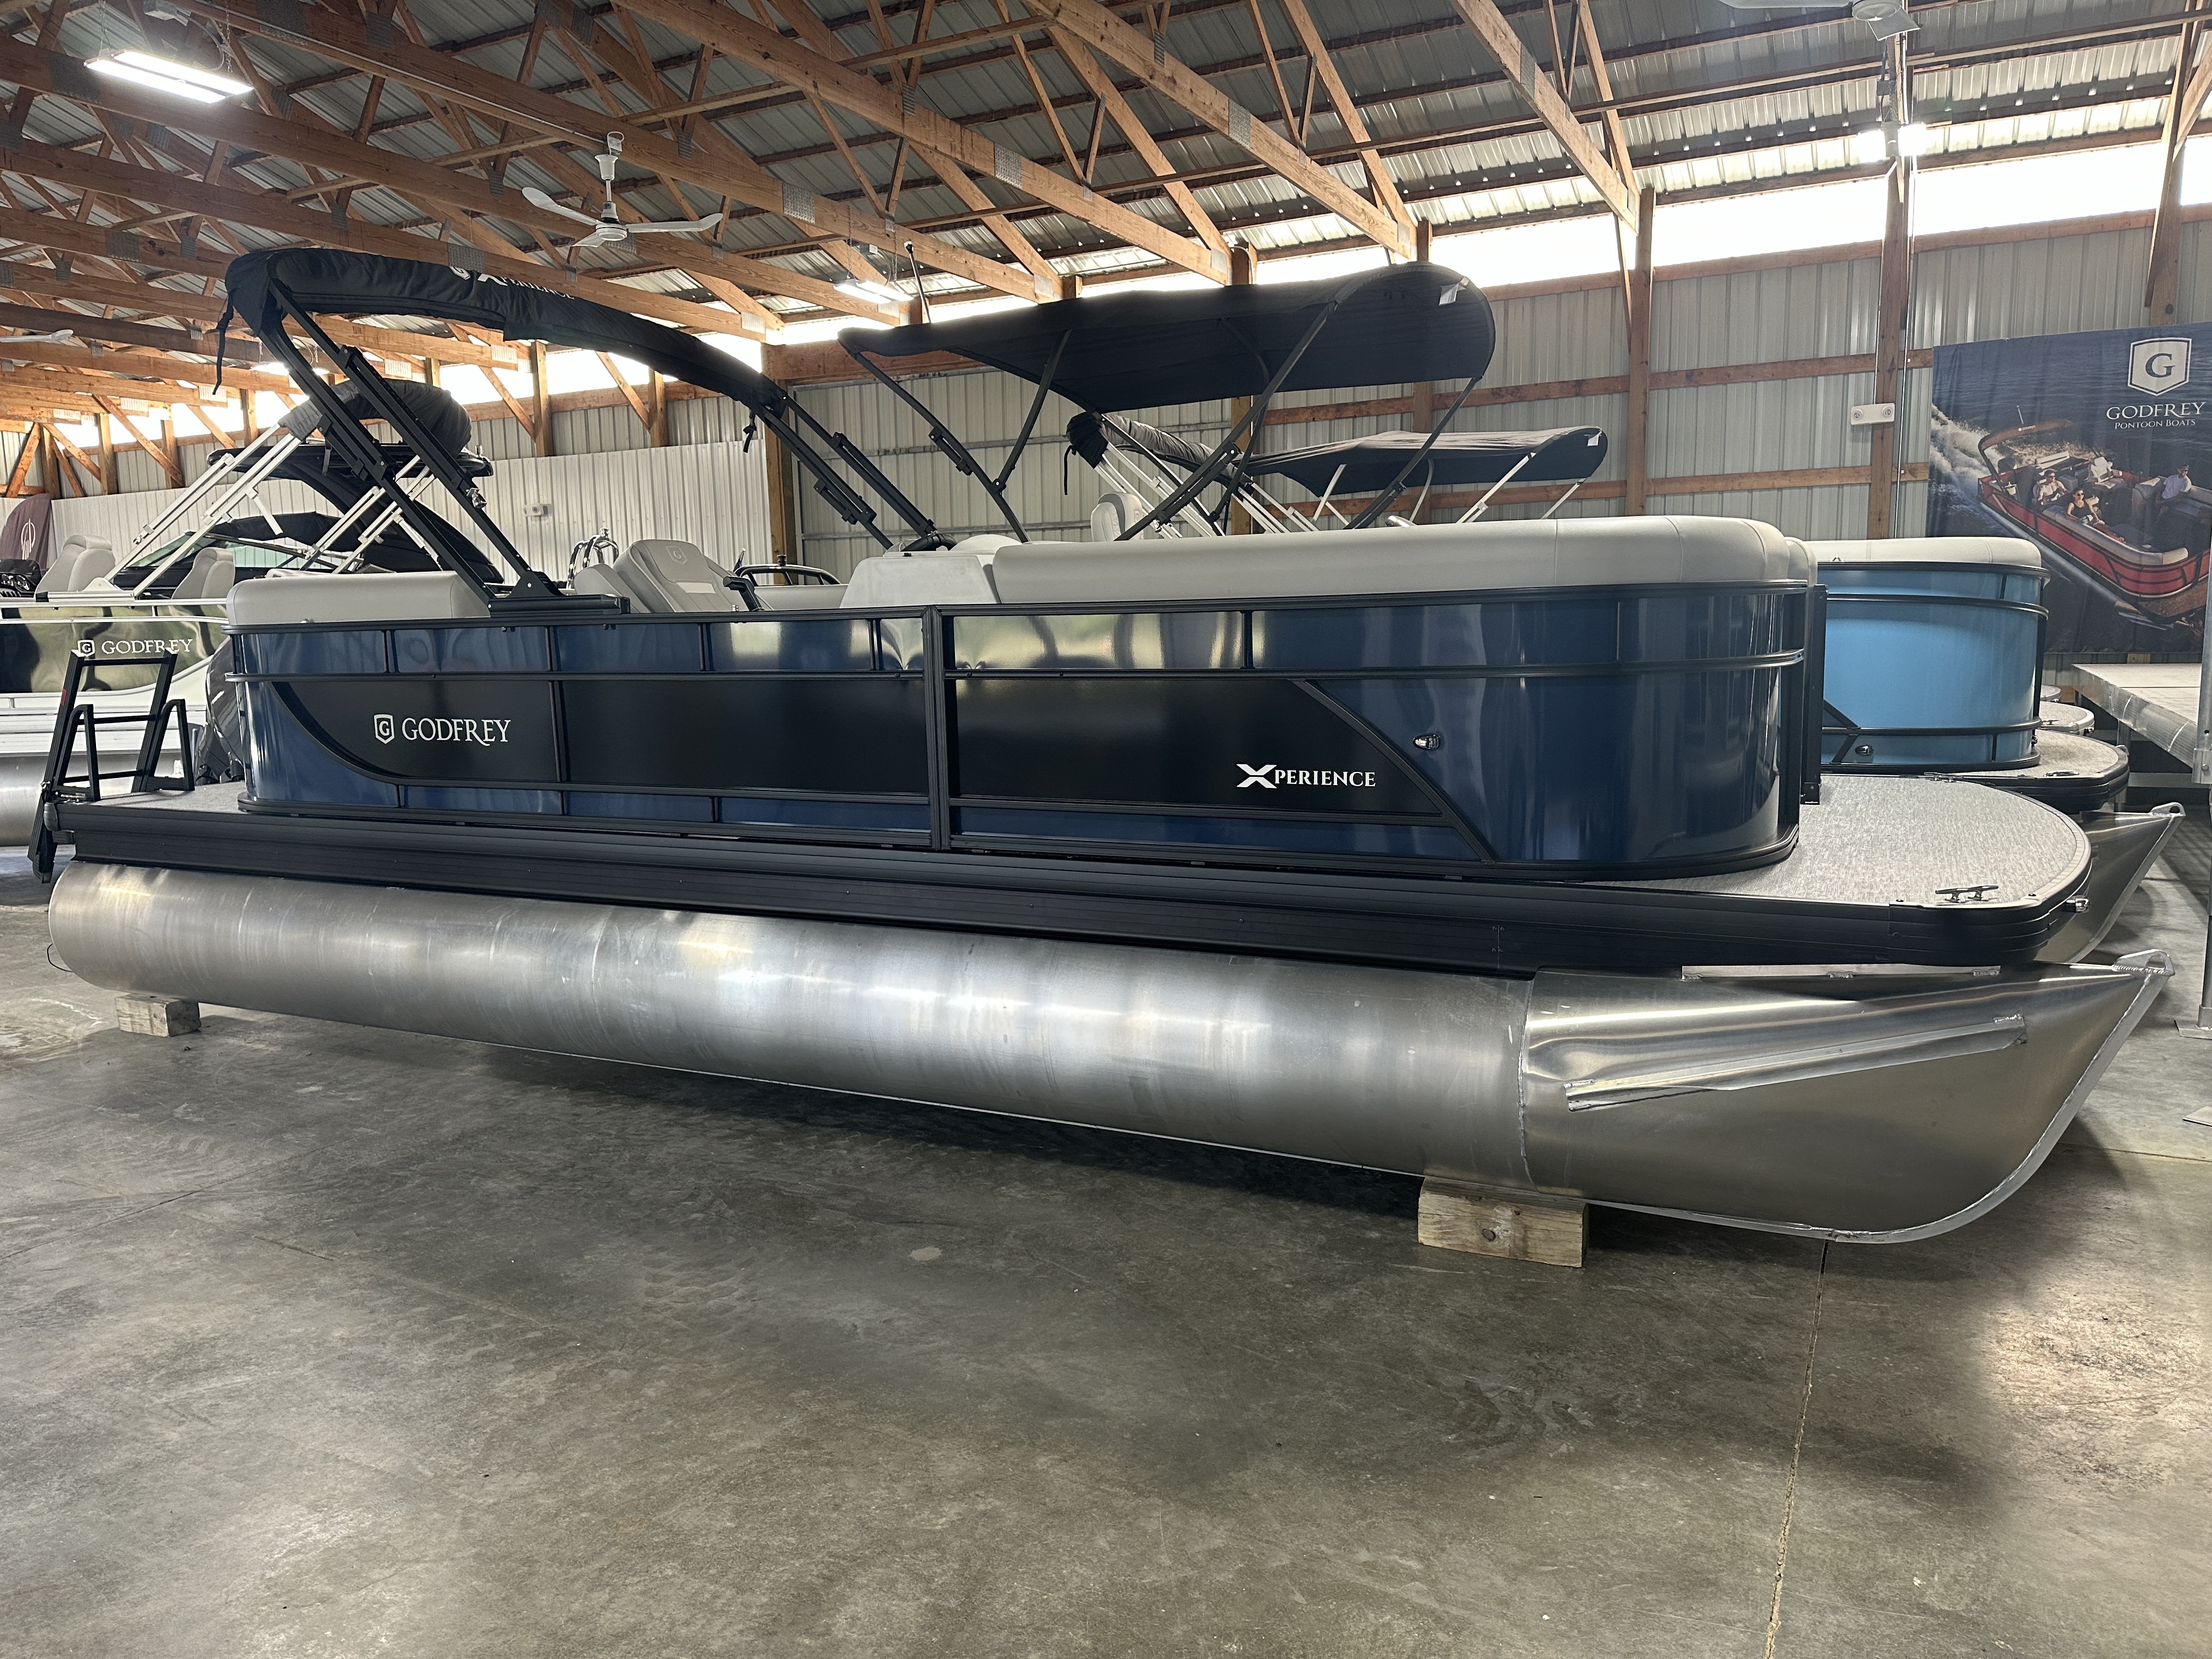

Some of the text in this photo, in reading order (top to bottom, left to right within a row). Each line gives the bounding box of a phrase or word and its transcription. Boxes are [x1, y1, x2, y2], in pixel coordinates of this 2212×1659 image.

[2145, 353, 2175, 378] G
[2106, 402, 2207, 420] GODFREY
[2115, 419, 2196, 430] PONTOON BOATS
[101, 639, 193, 654] GODFREY
[379, 717, 511, 747] G GODFREY
[1236, 763, 1376, 789] XPERIENCE
